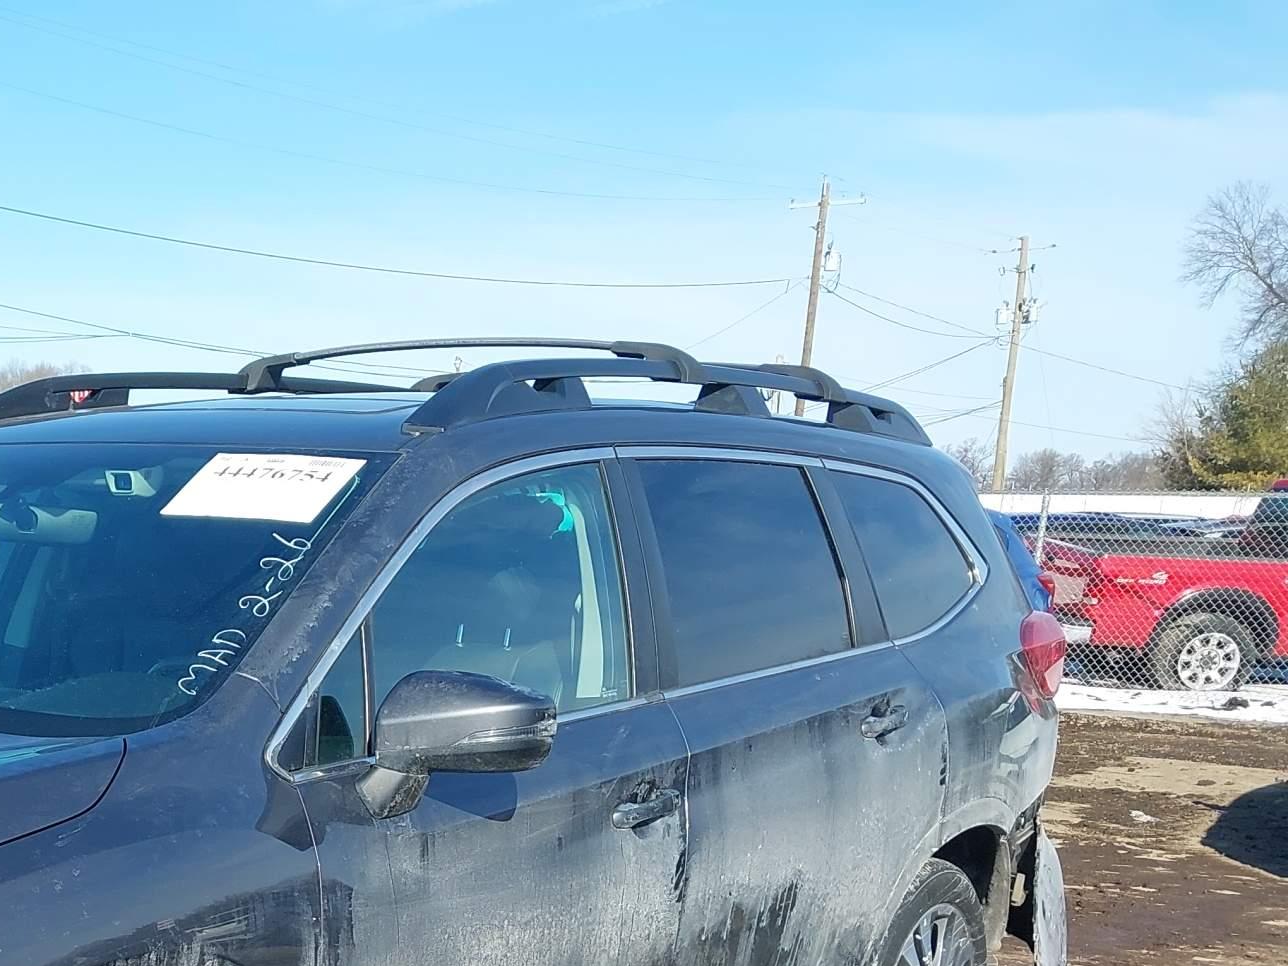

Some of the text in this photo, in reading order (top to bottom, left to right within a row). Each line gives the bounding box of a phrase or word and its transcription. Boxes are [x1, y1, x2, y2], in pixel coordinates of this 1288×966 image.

[214, 466, 333, 483] 44476754
[178, 629, 247, 696] MAD
[239, 532, 312, 618] 2-26
